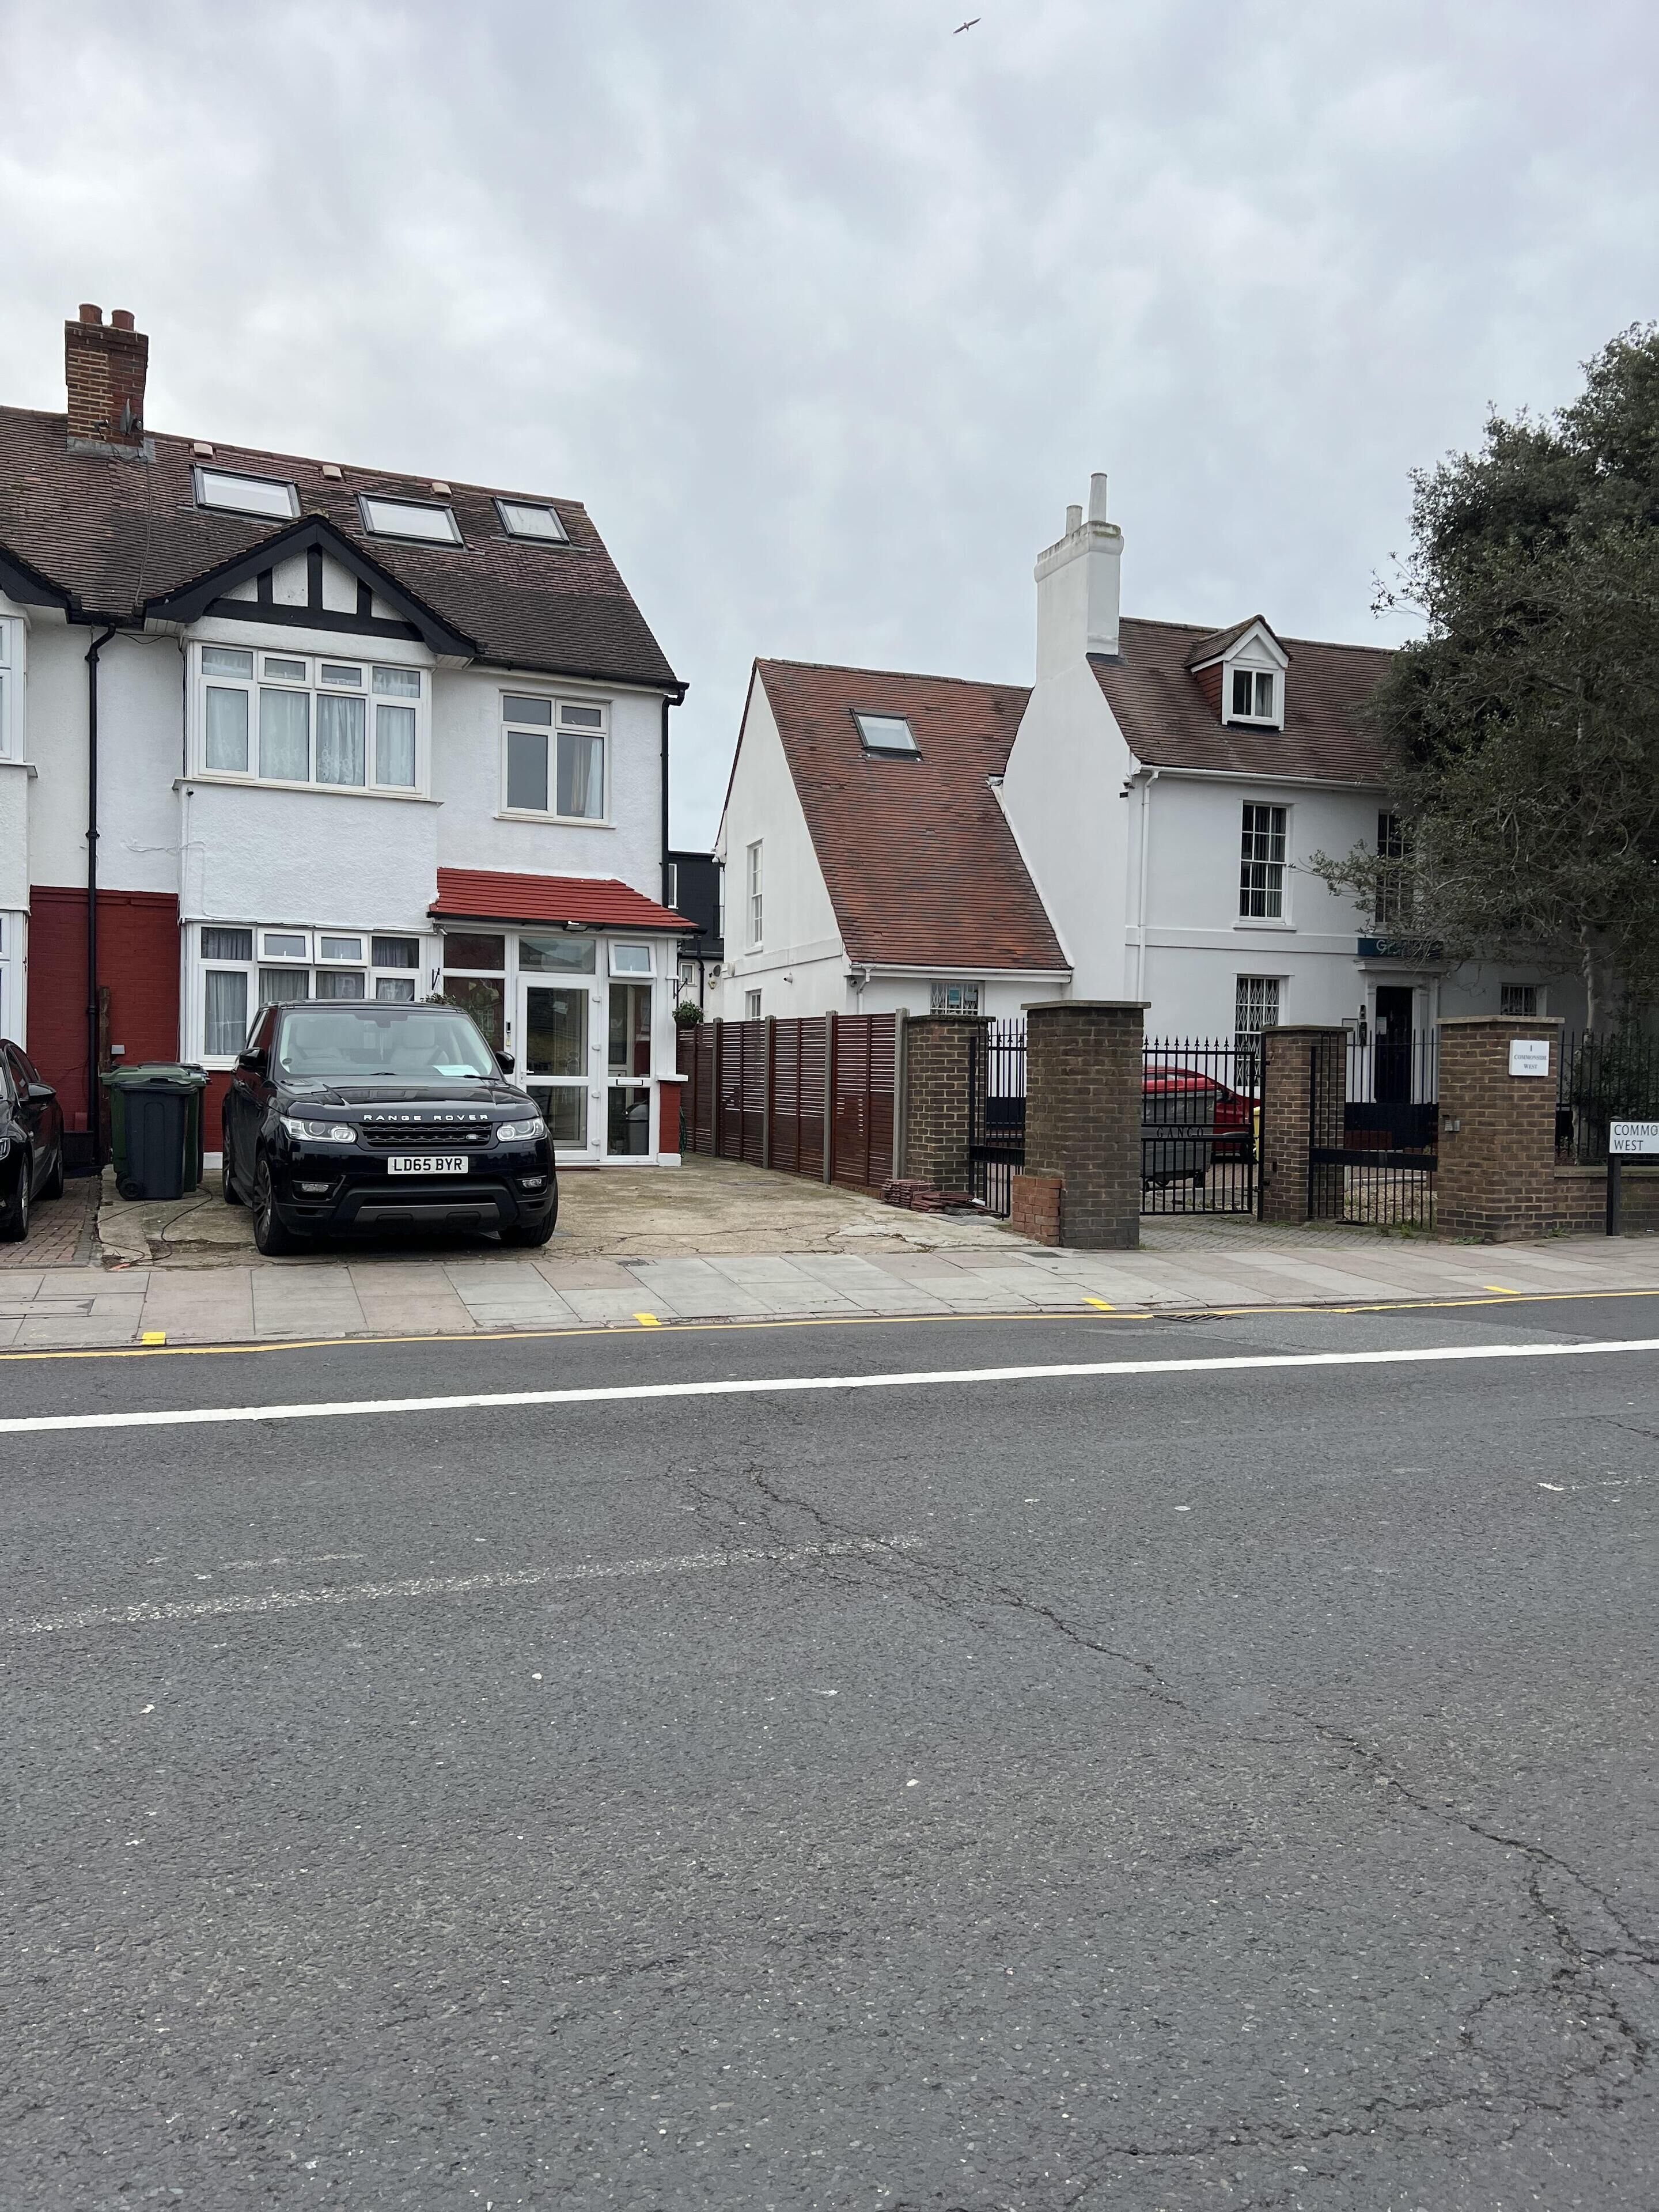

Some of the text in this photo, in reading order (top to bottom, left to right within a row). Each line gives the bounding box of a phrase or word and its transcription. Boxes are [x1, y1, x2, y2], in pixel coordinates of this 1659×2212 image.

[1156, 1127, 1203, 1138] GANCO
[1614, 1124, 1659, 1136] COMMO
[1614, 1140, 1643, 1151] WEST
[394, 1158, 462, 1171] LD65 BYR
